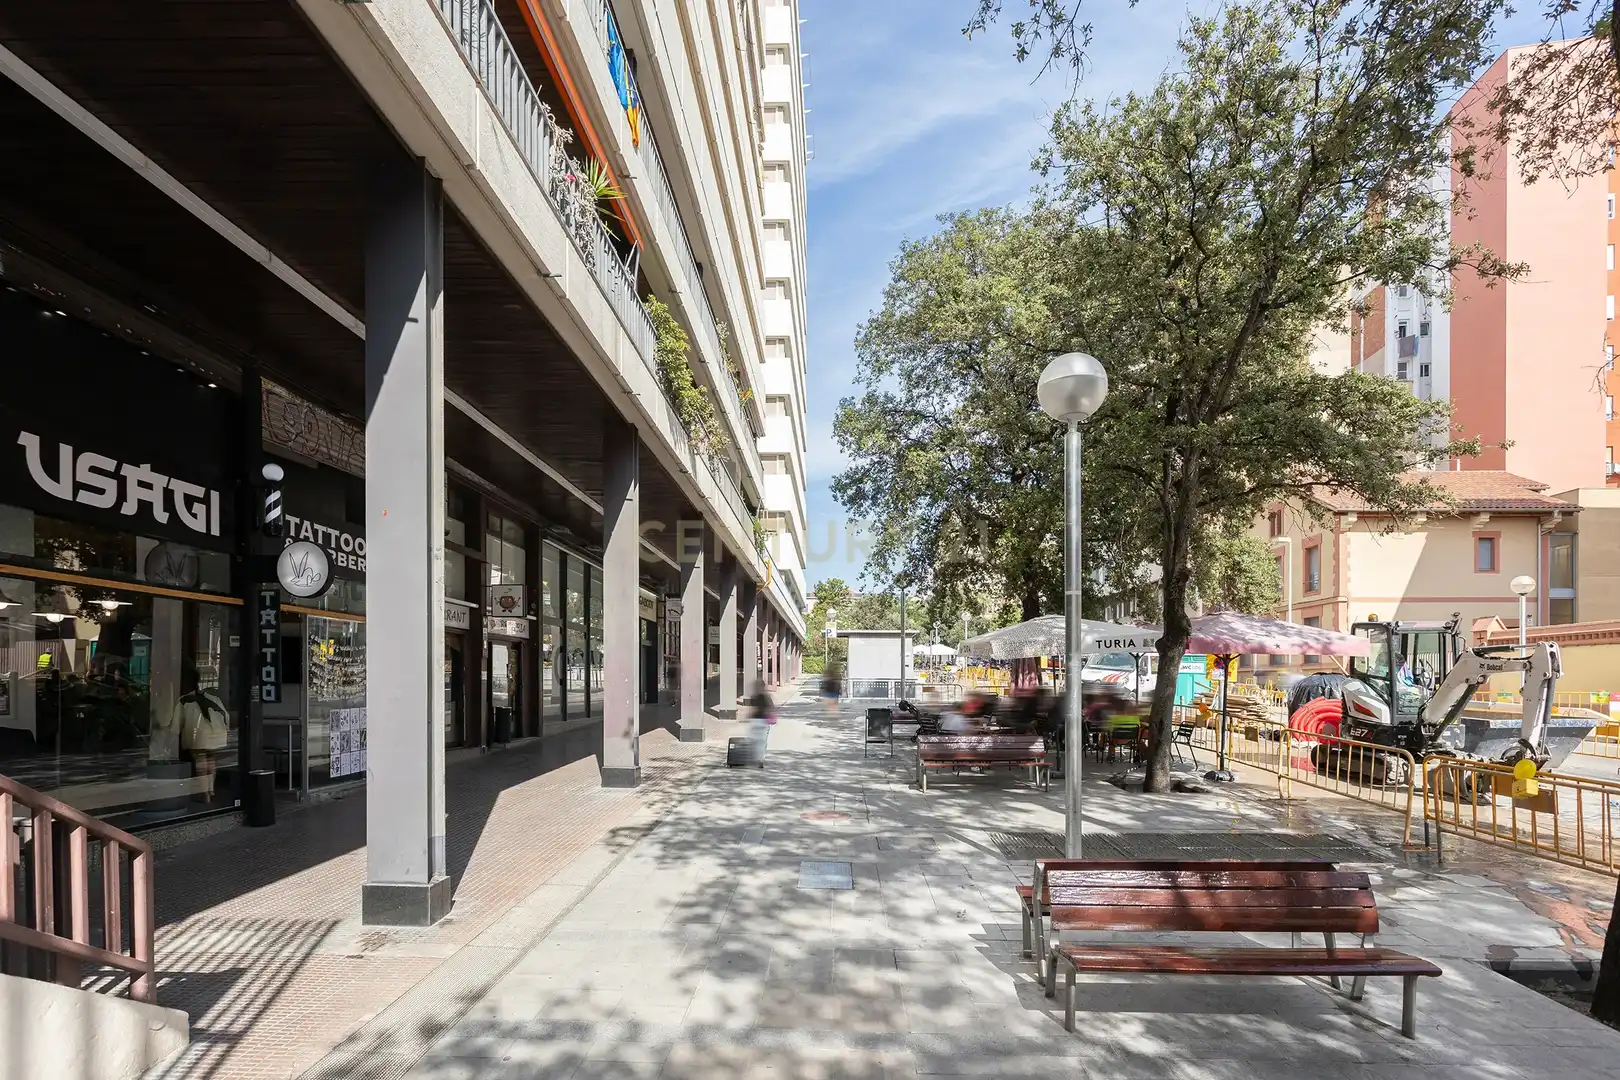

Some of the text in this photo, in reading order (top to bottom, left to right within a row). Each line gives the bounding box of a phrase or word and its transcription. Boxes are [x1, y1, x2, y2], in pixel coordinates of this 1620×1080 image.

[17, 431, 220, 536] USAGI
[285, 513, 366, 556] TATTOO
[260, 591, 276, 701] TATTOO
[1095, 638, 1136, 649] TURIA
[1486, 663, 1504, 671] Bobcat
